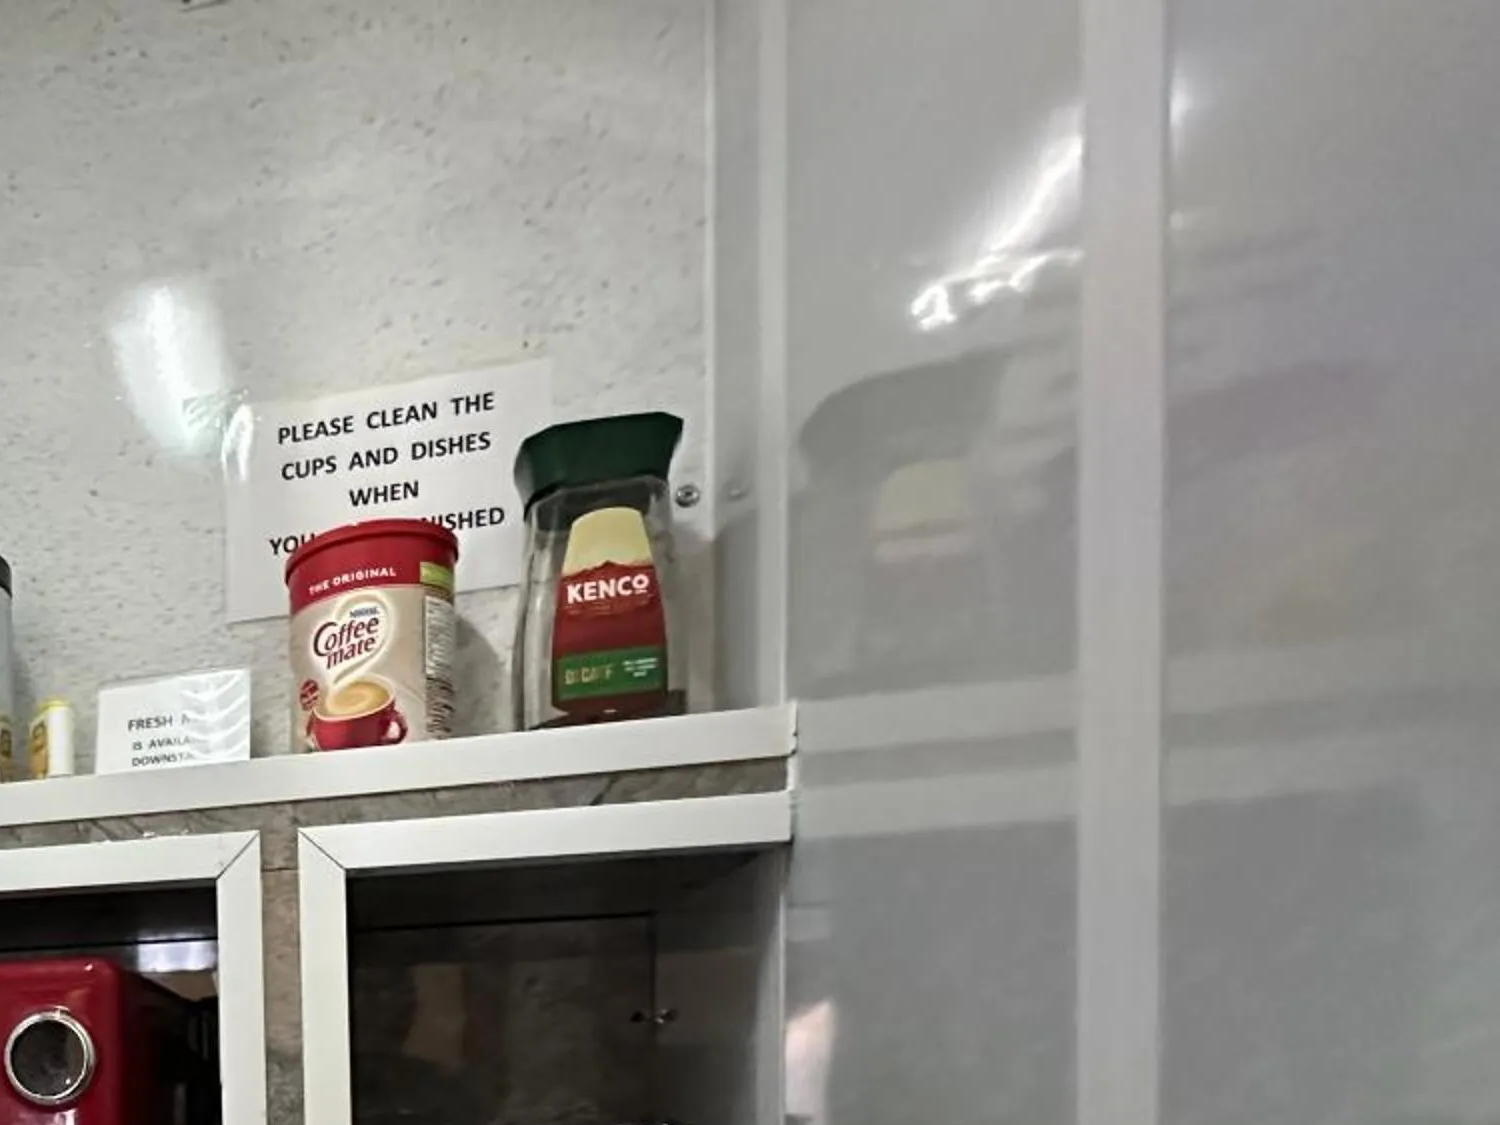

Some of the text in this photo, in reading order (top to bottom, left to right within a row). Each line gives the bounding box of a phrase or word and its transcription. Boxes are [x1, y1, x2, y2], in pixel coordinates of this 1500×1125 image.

[278, 392, 495, 444] PLEASE CLEAN THE
[281, 432, 491, 480] CUPS AND DISHES
[349, 480, 419, 507] WHEN
[421, 507, 505, 532] ISHED
[308, 567, 397, 595] THE ORIGINAL
[566, 573, 649, 604] KENCO
[313, 617, 379, 657] Coffee
[326, 636, 376, 669] mate
[128, 713, 173, 732] FRESH
